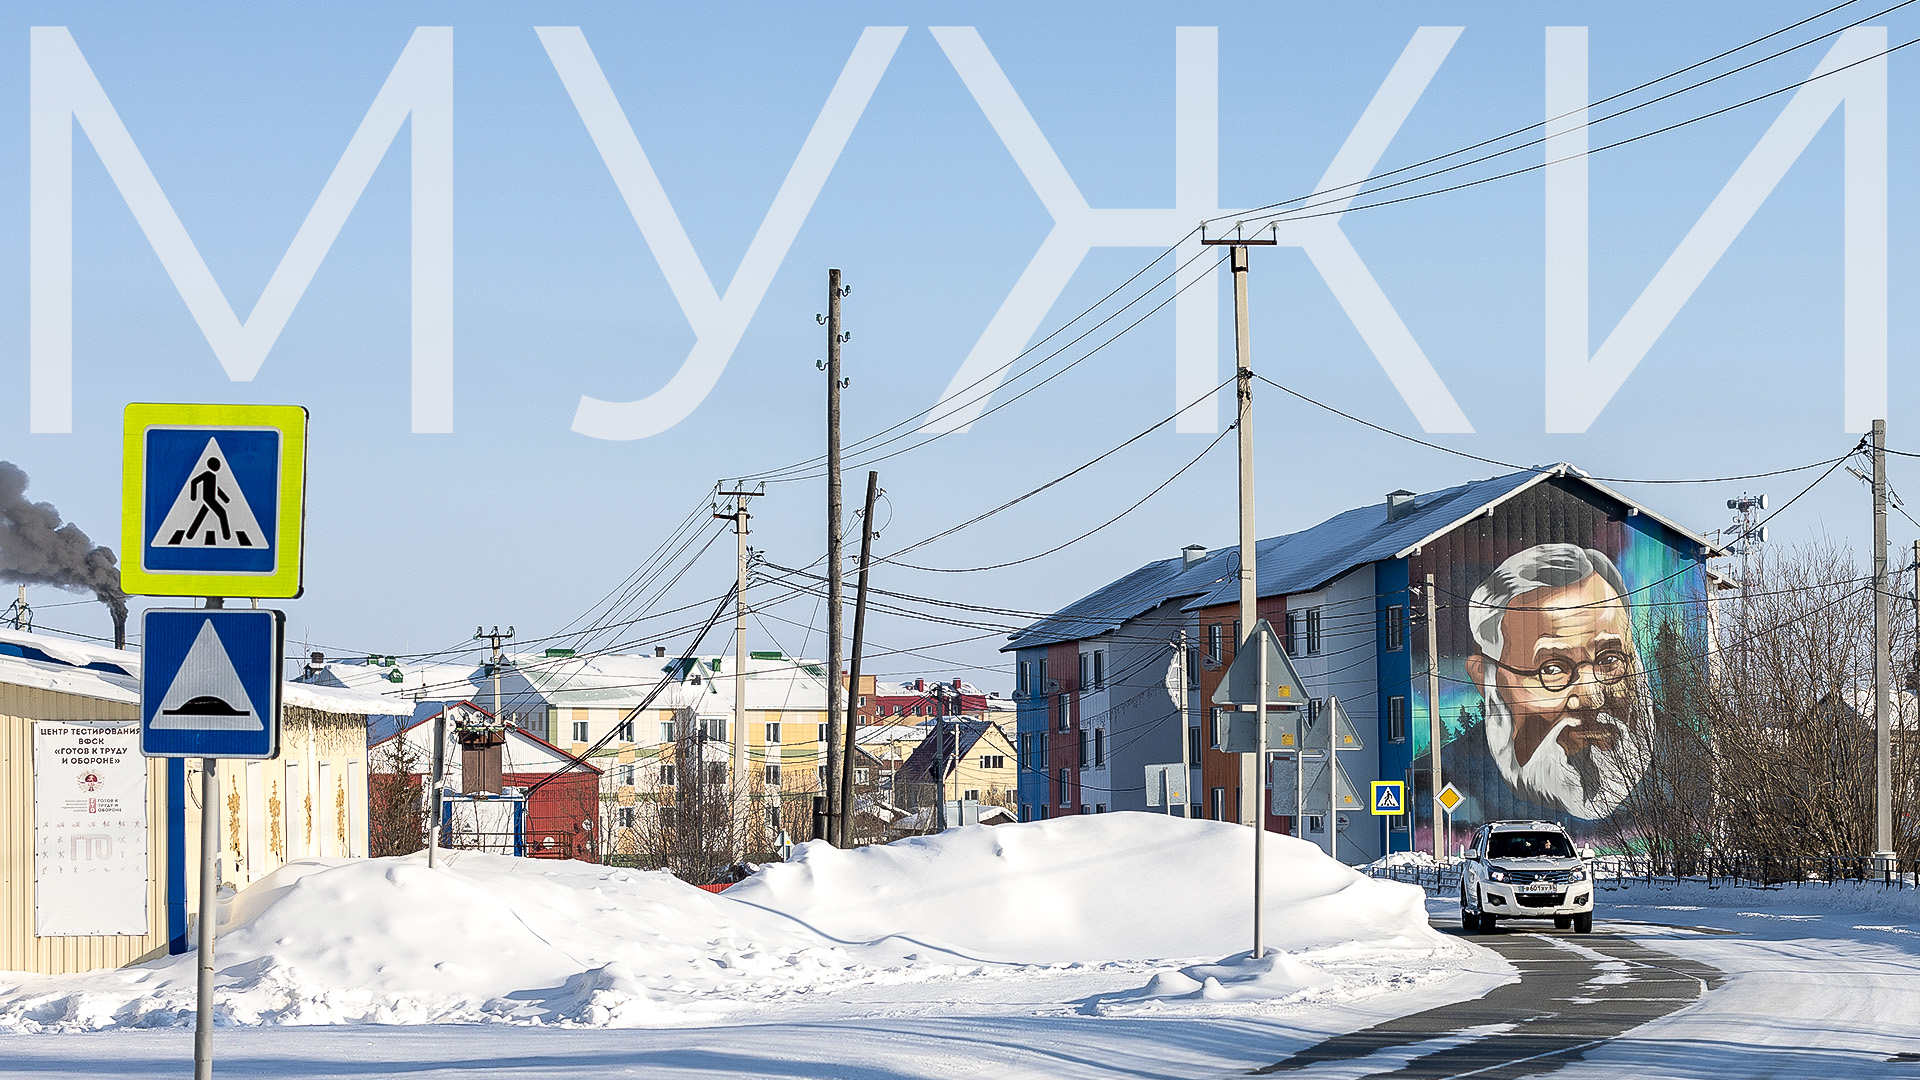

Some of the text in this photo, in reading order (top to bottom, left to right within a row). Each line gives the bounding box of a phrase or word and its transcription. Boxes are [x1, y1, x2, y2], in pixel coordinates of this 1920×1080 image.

[40, 727, 140, 736] ЦЕНТР ТЕСТИРОВАНИЯ
[54, 747, 90, 755] «ГОТОВ
[100, 747, 128, 755] ТРУДУ
[61, 757, 121, 765] И ОБОРОНЕ»
[70, 833, 113, 861] ГТО
